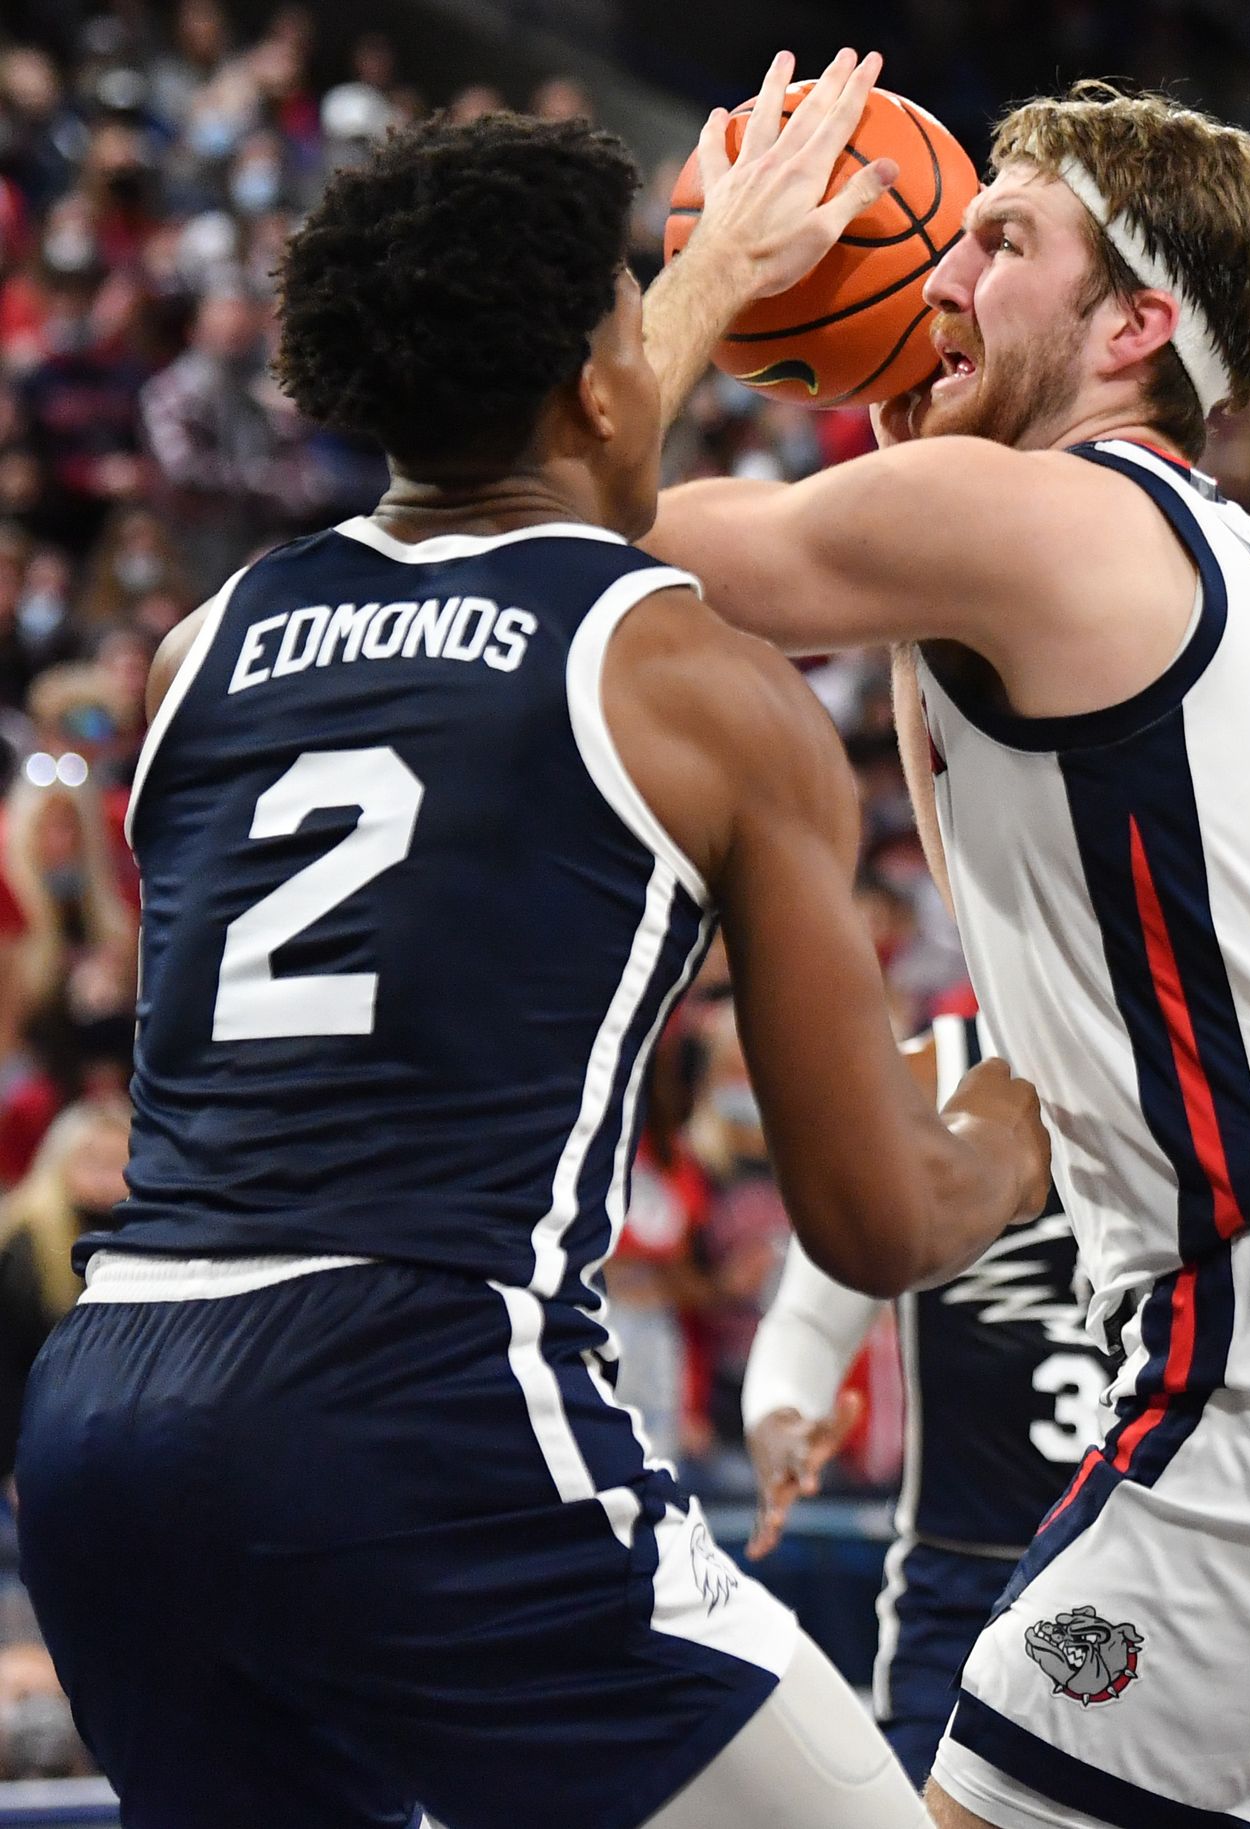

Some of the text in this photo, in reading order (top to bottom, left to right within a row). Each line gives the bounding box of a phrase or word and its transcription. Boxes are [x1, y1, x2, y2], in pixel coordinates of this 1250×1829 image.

[227, 596, 539, 695] EDMONDS
[211, 745, 425, 1042] 2
[1029, 1353, 1111, 1463] 3
